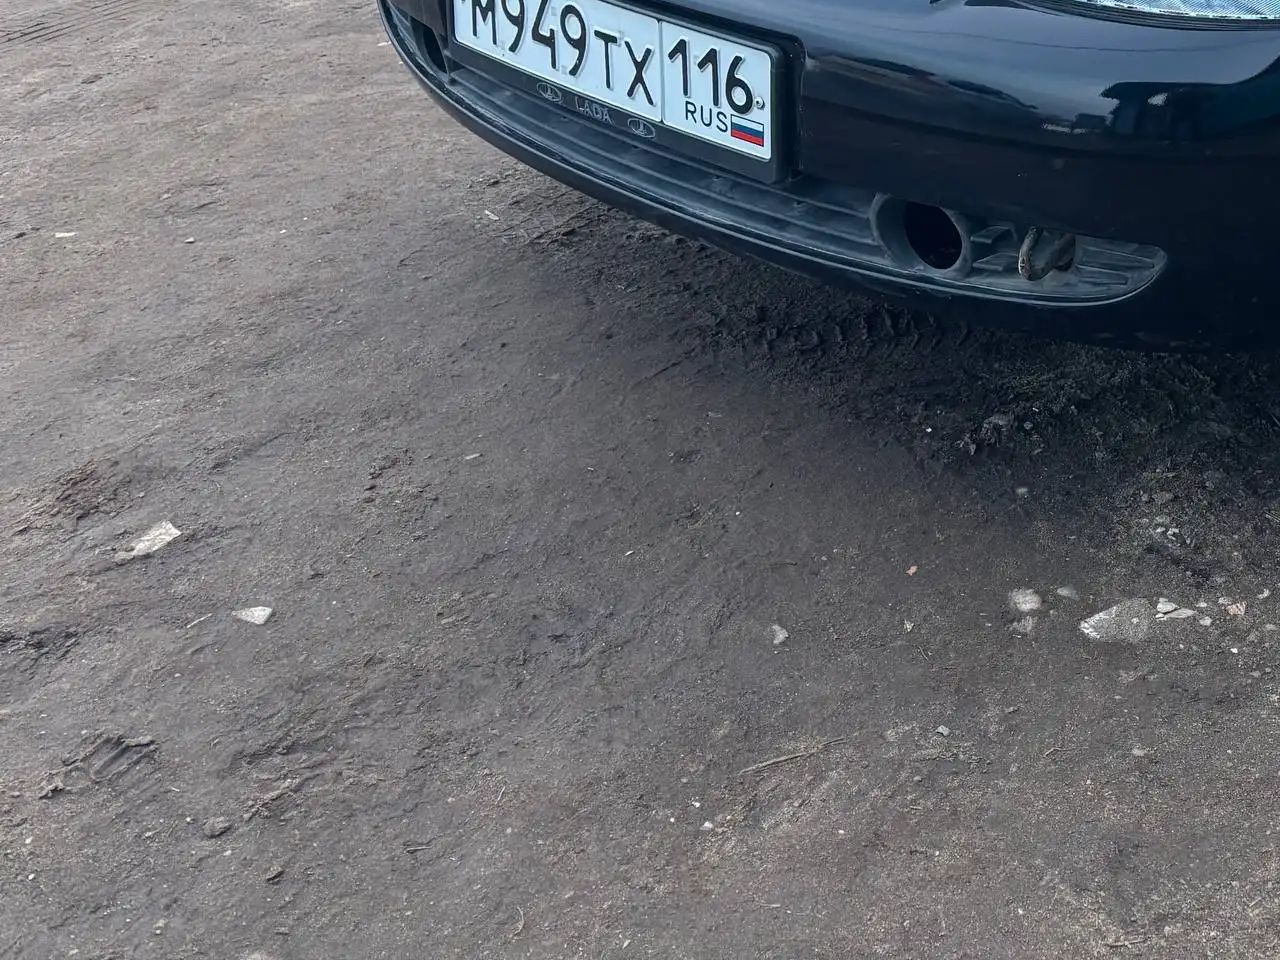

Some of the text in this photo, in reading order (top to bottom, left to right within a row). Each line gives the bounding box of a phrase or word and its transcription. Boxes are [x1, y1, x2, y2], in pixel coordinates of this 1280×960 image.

[667, 38, 754, 115] 116
[575, 96, 615, 126] LADA
[685, 101, 728, 133] RUS
